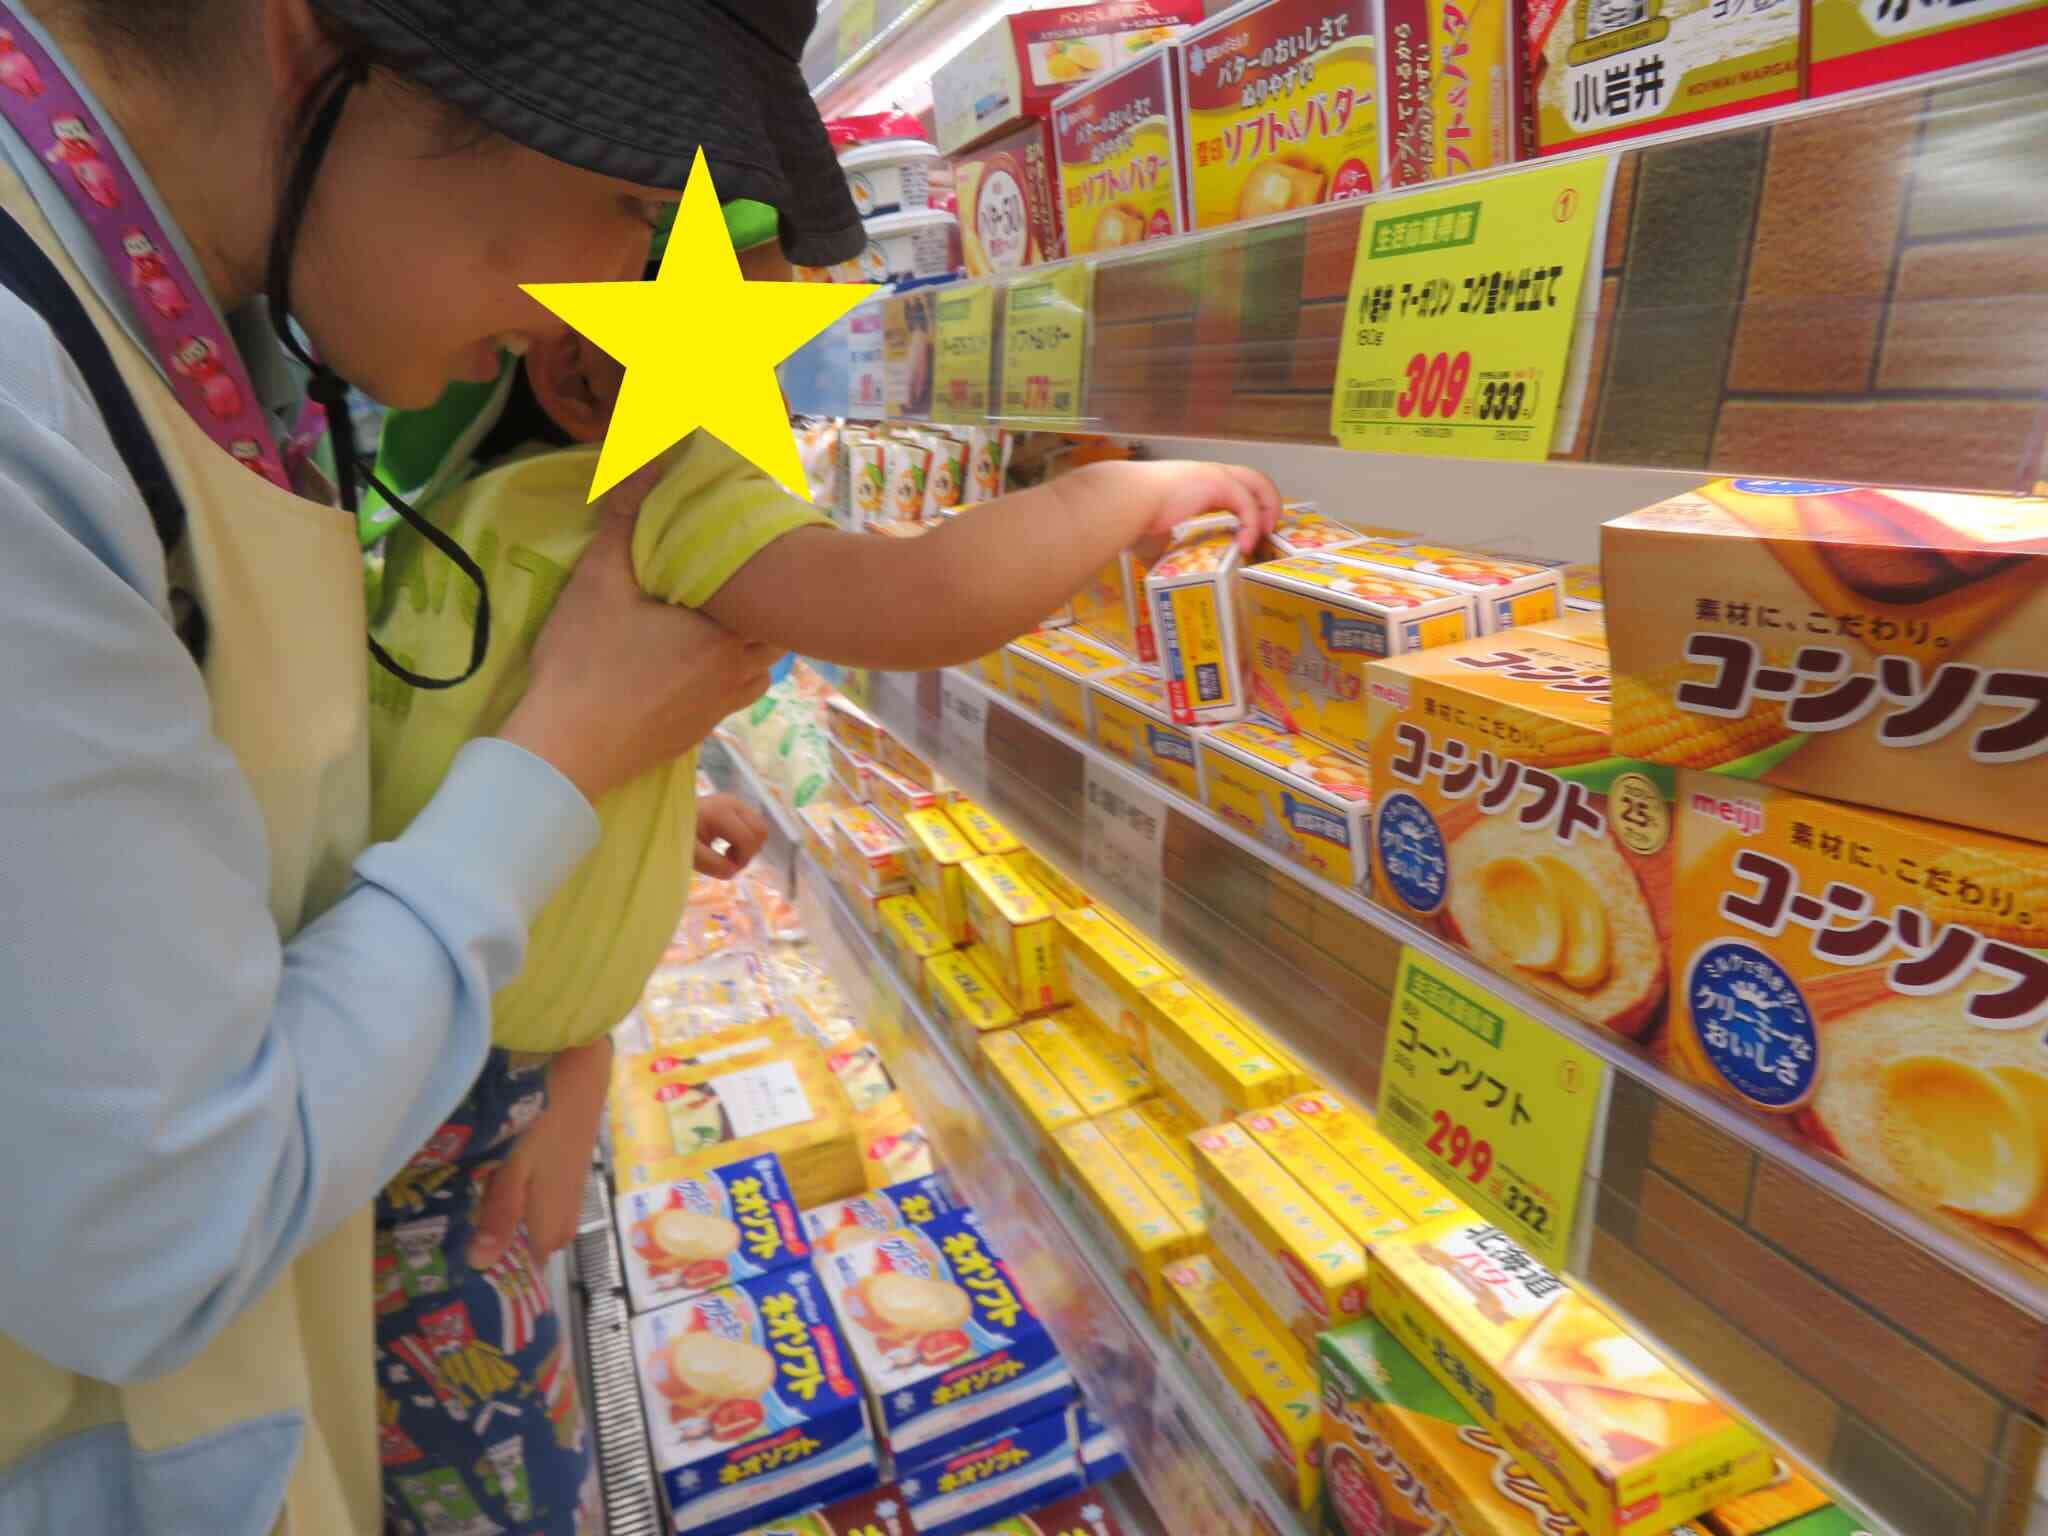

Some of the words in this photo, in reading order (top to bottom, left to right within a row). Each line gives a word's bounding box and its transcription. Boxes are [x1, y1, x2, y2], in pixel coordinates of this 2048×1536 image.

[1573, 53, 1664, 123] 小岩井
[1396, 351, 1471, 419] 309
[1478, 380, 1527, 421] 333
[1695, 597, 1952, 649] 素材に、こだわり。
[1390, 722, 1605, 846] コーンソフト
[1690, 792, 1763, 836] meiji
[1788, 820, 2034, 927] 素材に、こだわり。
[1397, 1019, 1532, 1126] コーンソフト
[1703, 1017, 1801, 1087] おいしさ
[1424, 1109, 1493, 1185] 299
[729, 1176, 784, 1260] ネオソフト
[1503, 1185, 1550, 1234] 322
[943, 1231, 1023, 1328] ネオソフト
[1463, 1223, 1571, 1299] 北海道
[759, 1292, 826, 1402] ネオソフト
